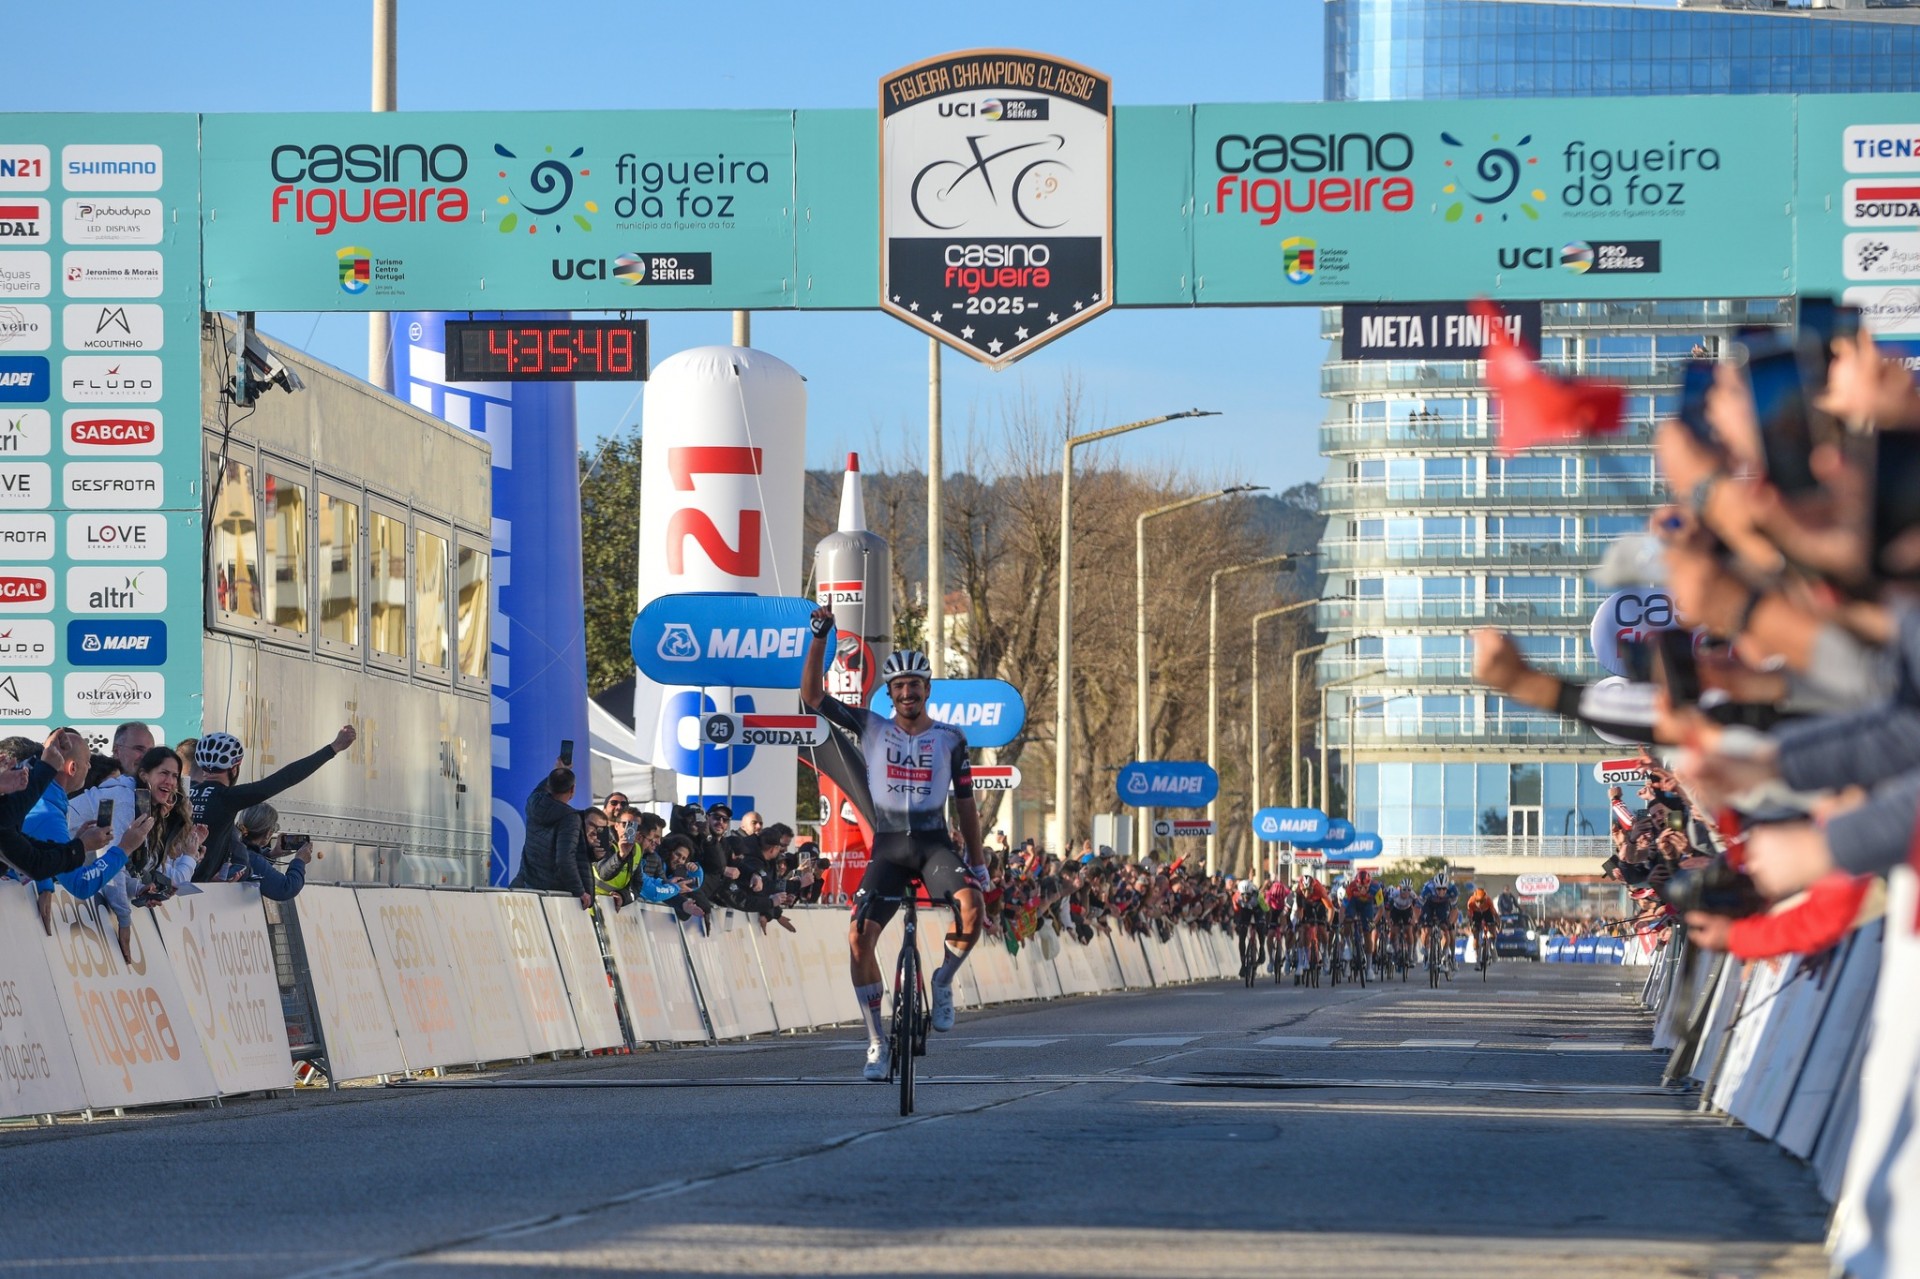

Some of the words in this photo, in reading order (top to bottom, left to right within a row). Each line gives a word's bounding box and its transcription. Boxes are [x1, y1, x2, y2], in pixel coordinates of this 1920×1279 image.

[889, 67, 950, 106] FIGUEIRA
[952, 61, 1035, 87] CHAMPIONS
[1037, 66, 1095, 100] CLASSIC
[938, 103, 976, 117] UCI
[1007, 102, 1026, 110] PRO
[1007, 109, 1038, 118] SERIES
[1215, 133, 1414, 173] casino
[1563, 140, 1720, 181] figueira
[68, 161, 156, 174] SHIMANO
[271, 144, 468, 183] casino
[615, 153, 769, 193] figueira
[1562, 175, 1612, 206] da
[1625, 174, 1686, 205] foz
[614, 187, 663, 218] da
[676, 187, 735, 218] foz
[1216, 175, 1414, 226] figueira
[271, 184, 469, 235] figueira
[674, 221, 706, 231] figueira
[709, 221, 720, 229] da
[722, 220, 736, 229] foz
[944, 244, 1050, 267] casino
[1499, 247, 1553, 269] UCI
[1598, 246, 1628, 257] PRO
[552, 259, 606, 280] UCI
[651, 257, 678, 268] PRO
[1597, 256, 1645, 269] SERIES
[86, 268, 123, 276] Jeronimo
[124, 268, 130, 276] &
[132, 268, 159, 276] Morais
[375, 273, 405, 281] Portugal
[651, 269, 695, 280] SERIES
[944, 266, 1050, 294] figueira
[0, 320, 39, 332] veiro
[1361, 316, 1425, 348] META
[1445, 315, 1522, 348] FINISH
[84, 340, 143, 348] MCOUTINHO
[488, 329, 632, 373] 4:35:48
[0, 372, 33, 386] APEI
[73, 380, 152, 389] FLUDO
[76, 425, 148, 440] SABGAL
[71, 480, 155, 491] GESFROTA
[88, 525, 146, 543] LOVE
[89, 586, 133, 608] altri
[103, 636, 149, 649] MAPEI
[707, 627, 807, 658] MAPEI
[77, 689, 152, 700] ostraveiro
[930, 703, 1001, 726] MAPEI
[711, 723, 729, 738] 25
[743, 730, 817, 745] SOUDAL
[886, 747, 933, 768] UAE
[891, 768, 928, 779] Emirates
[1602, 771, 1651, 784] SOUDA
[887, 784, 932, 795] XRG
[970, 778, 1012, 789] UDAL
[1151, 775, 1203, 793] MAPEI
[1173, 828, 1212, 836] SOUDAL
[1280, 819, 1318, 832] MAPEI
[73, 980, 181, 1093] figueira
